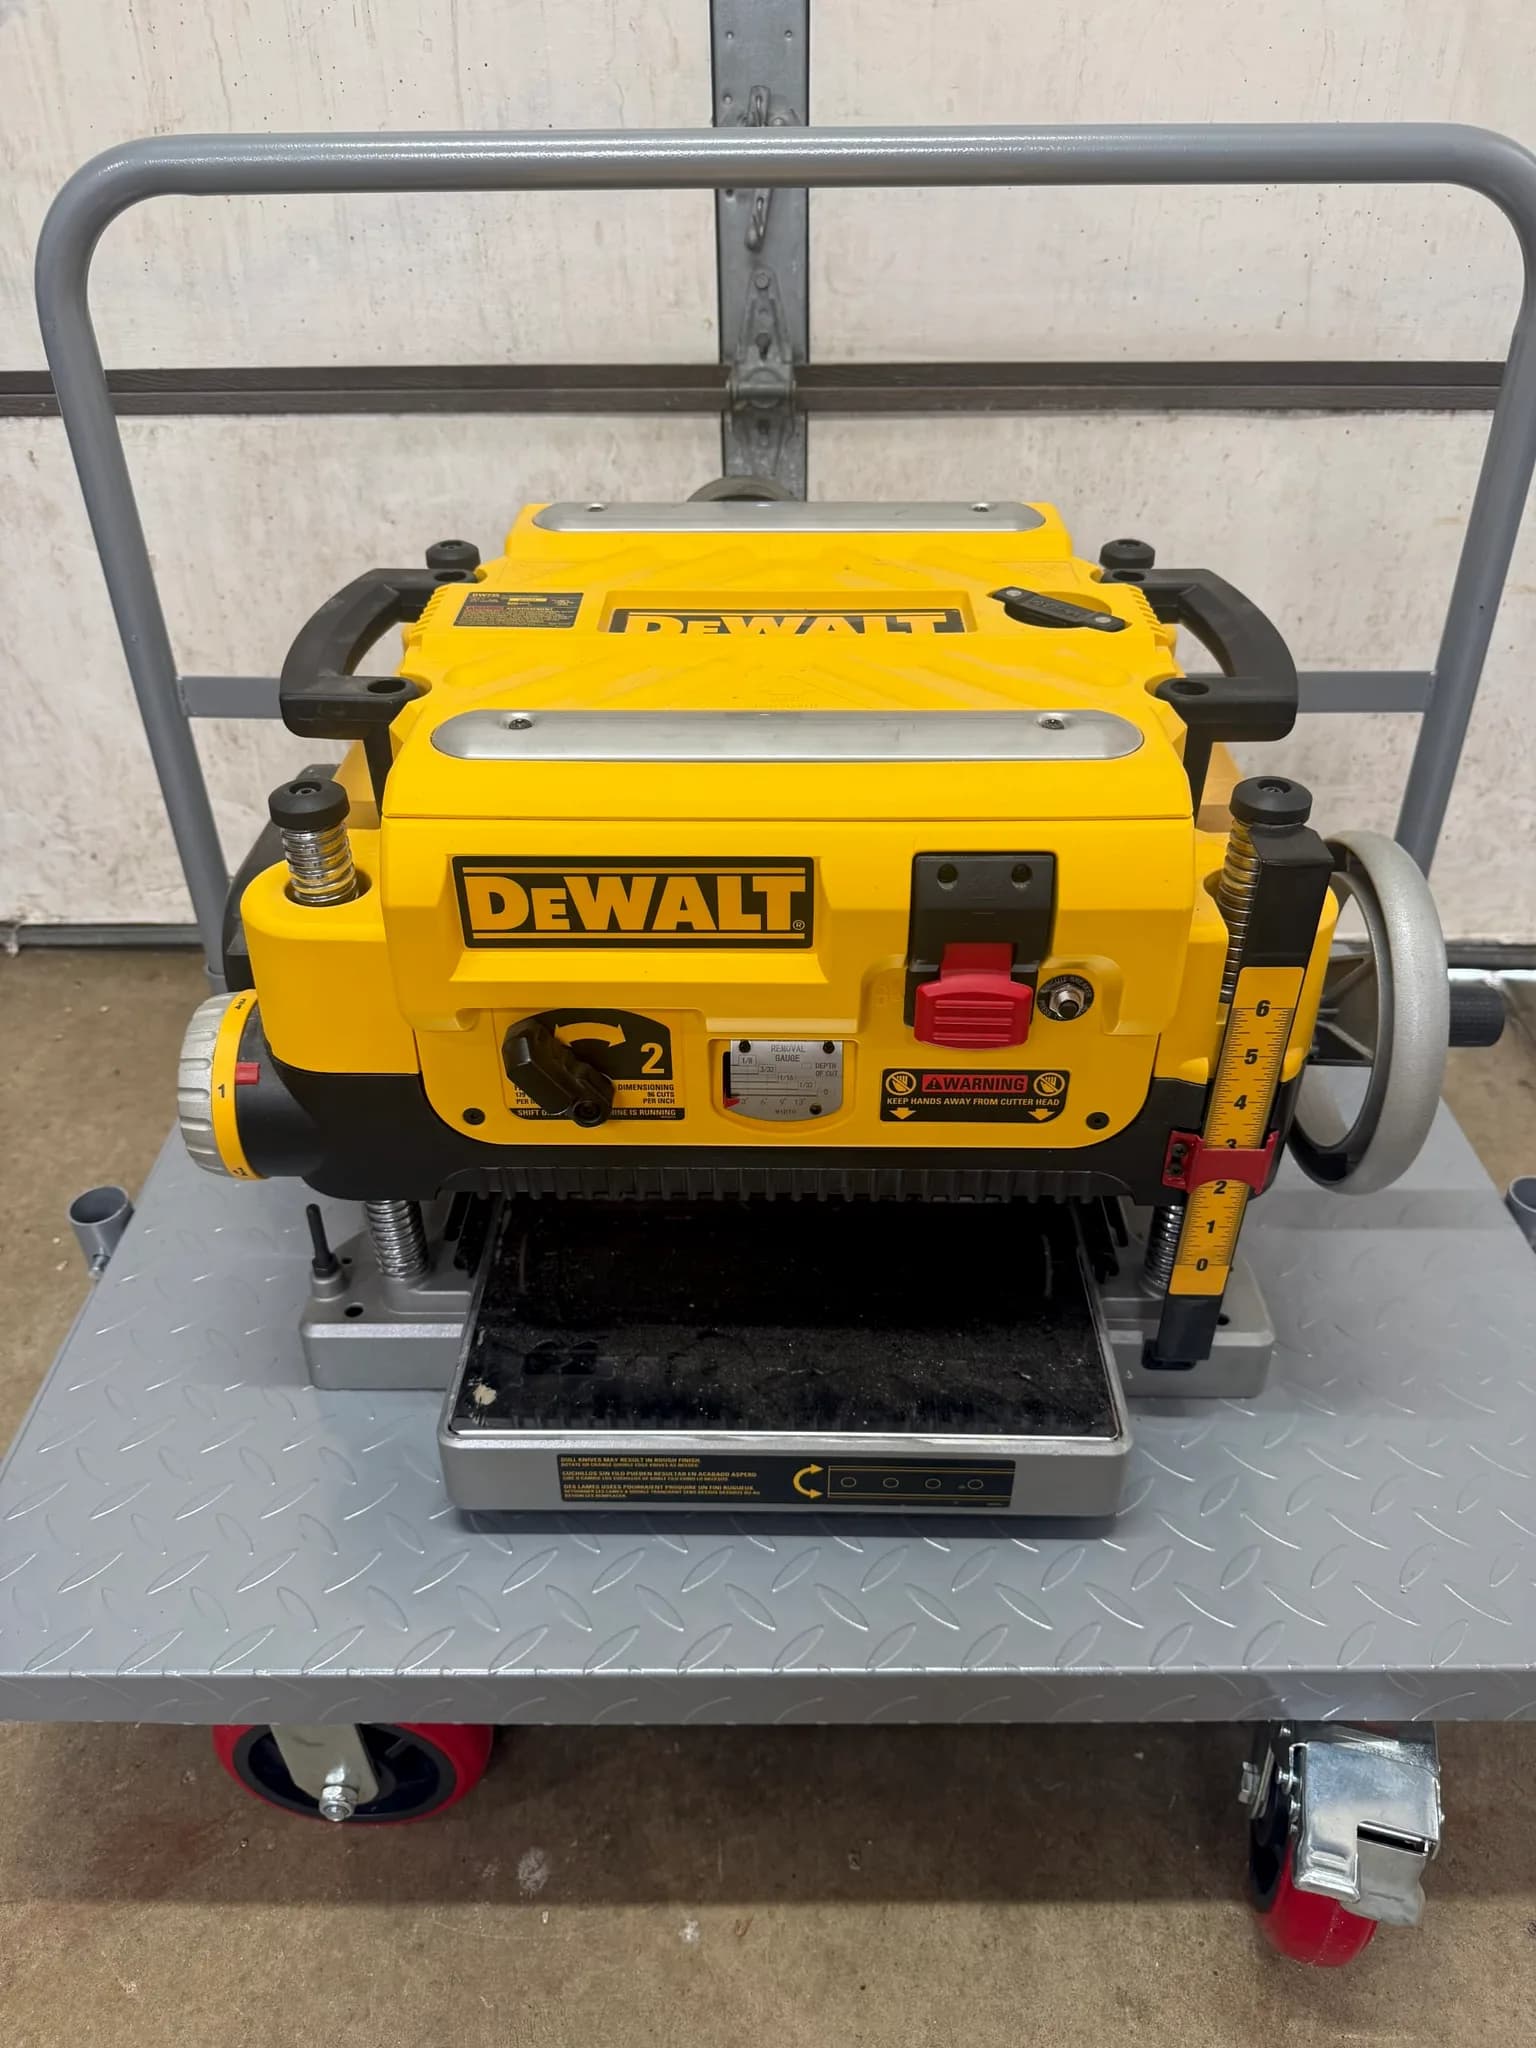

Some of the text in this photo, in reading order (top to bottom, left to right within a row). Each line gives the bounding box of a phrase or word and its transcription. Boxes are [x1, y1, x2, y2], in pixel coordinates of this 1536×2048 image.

[1255, 999, 1271, 1017] 6
[771, 1045, 806, 1053] REMOVAL
[640, 1042, 665, 1074] 2
[775, 1054, 800, 1062] GAUGE
[1244, 1048, 1259, 1065] 5
[815, 1062, 837, 1070] DEPTH
[217, 1083, 226, 1099] 1
[617, 1083, 675, 1091] DIMENSIONING
[942, 1077, 1025, 1092] WARNING
[887, 1097, 1060, 1106] KEEP HANDS AWAY FROM CUTTER HEAD
[1233, 1094, 1248, 1110] 4
[1213, 1180, 1227, 1194] 2
[1206, 1220, 1216, 1234] 1
[1195, 1258, 1208, 1272] 0
